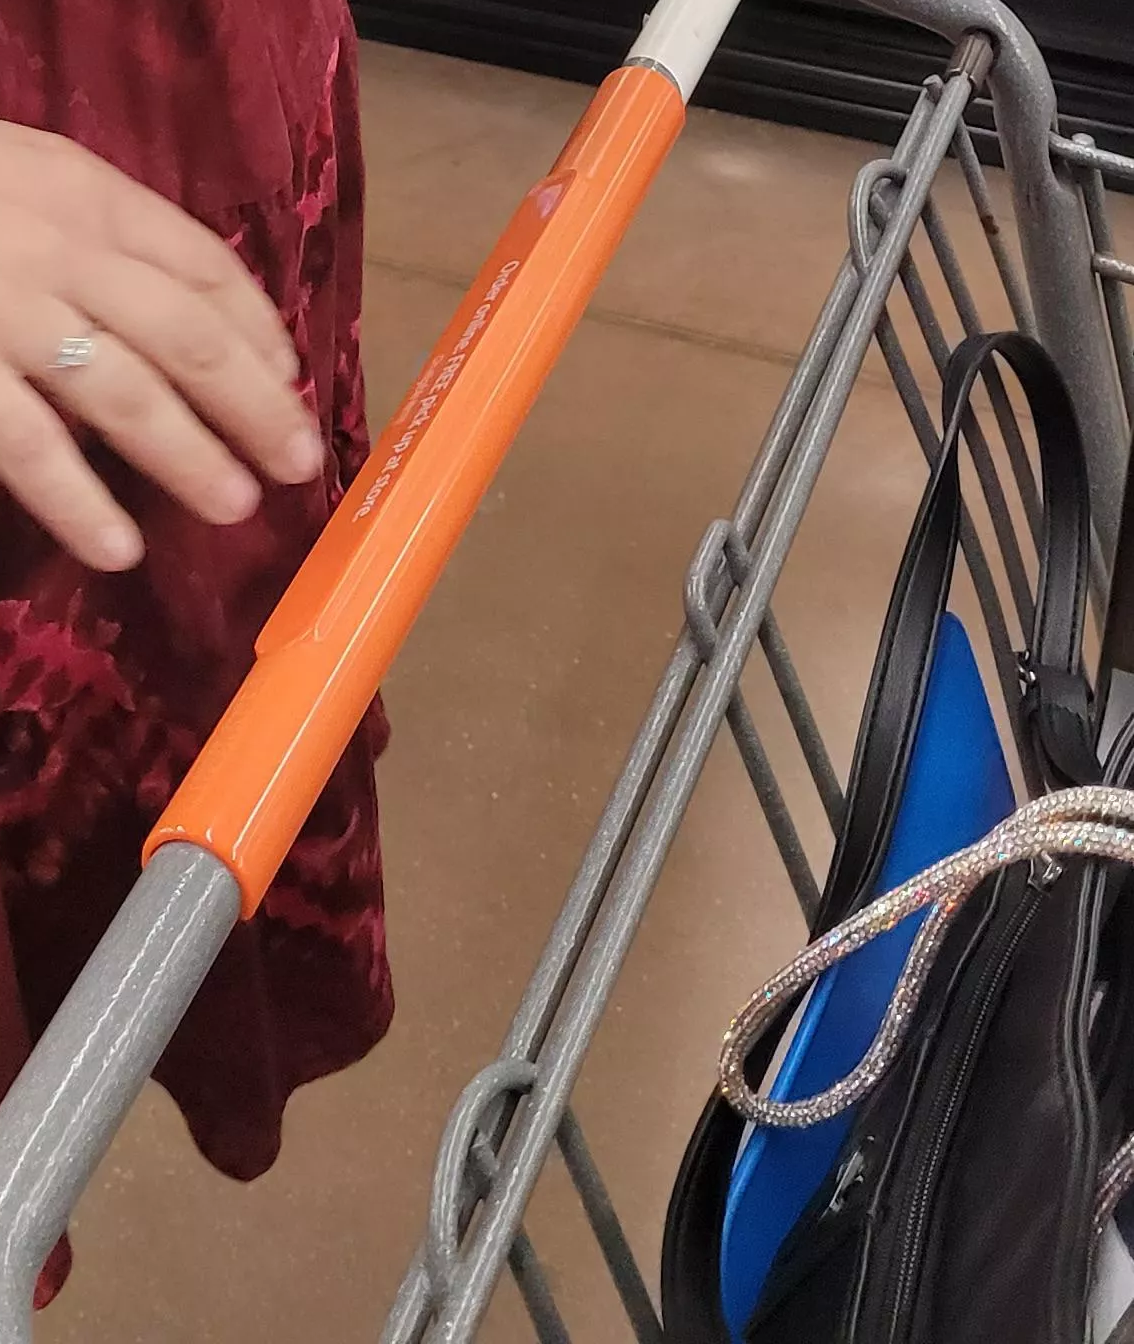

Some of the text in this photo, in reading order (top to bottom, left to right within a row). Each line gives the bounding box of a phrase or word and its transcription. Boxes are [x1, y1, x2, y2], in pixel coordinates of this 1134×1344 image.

[485, 260, 520, 301] Order
[430, 354, 465, 394] FREE
[408, 395, 437, 429] pick
[392, 430, 417, 455] up
[382, 453, 403, 474] at
